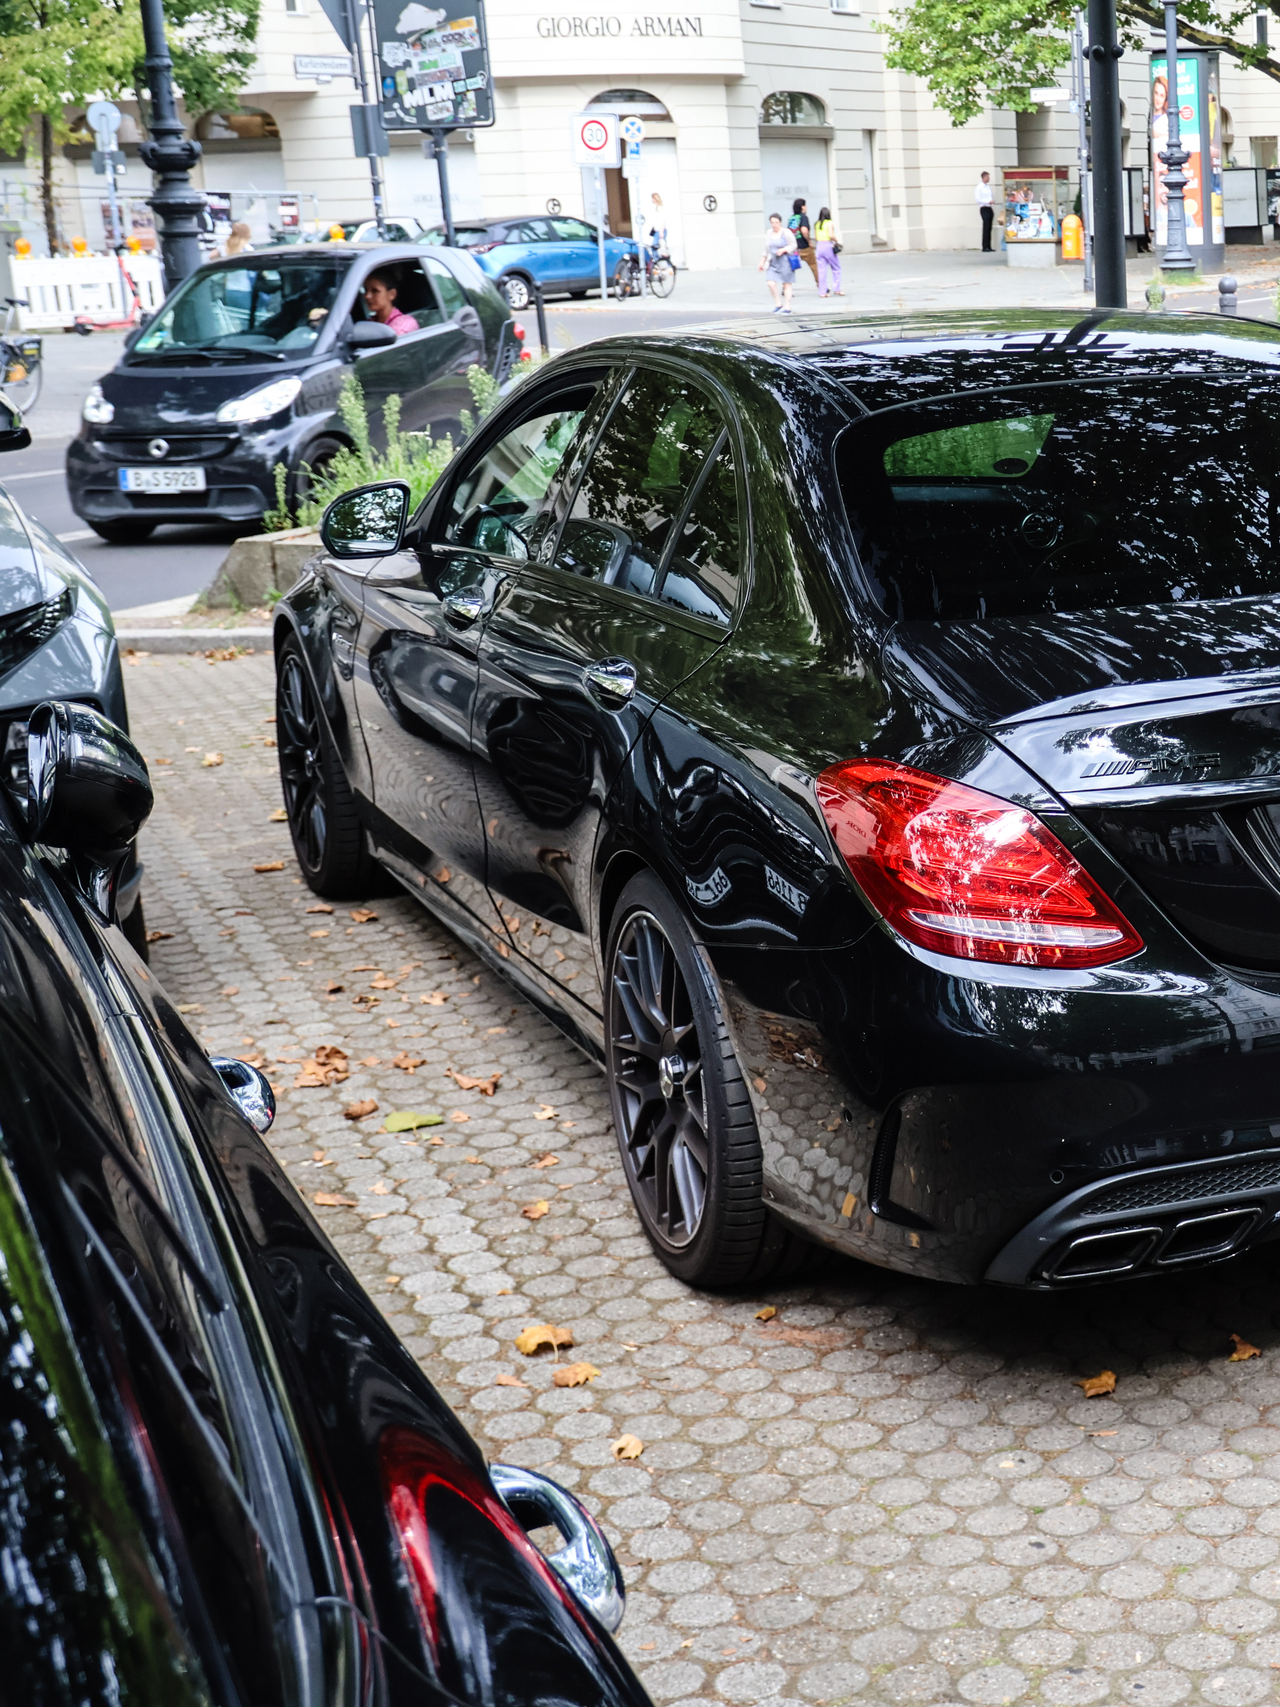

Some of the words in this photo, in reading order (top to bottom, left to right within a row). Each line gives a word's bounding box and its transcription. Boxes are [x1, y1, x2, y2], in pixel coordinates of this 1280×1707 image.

[537, 16, 621, 38] GIORGIO
[630, 16, 703, 37] ARMANI
[586, 128, 603, 142] 30
